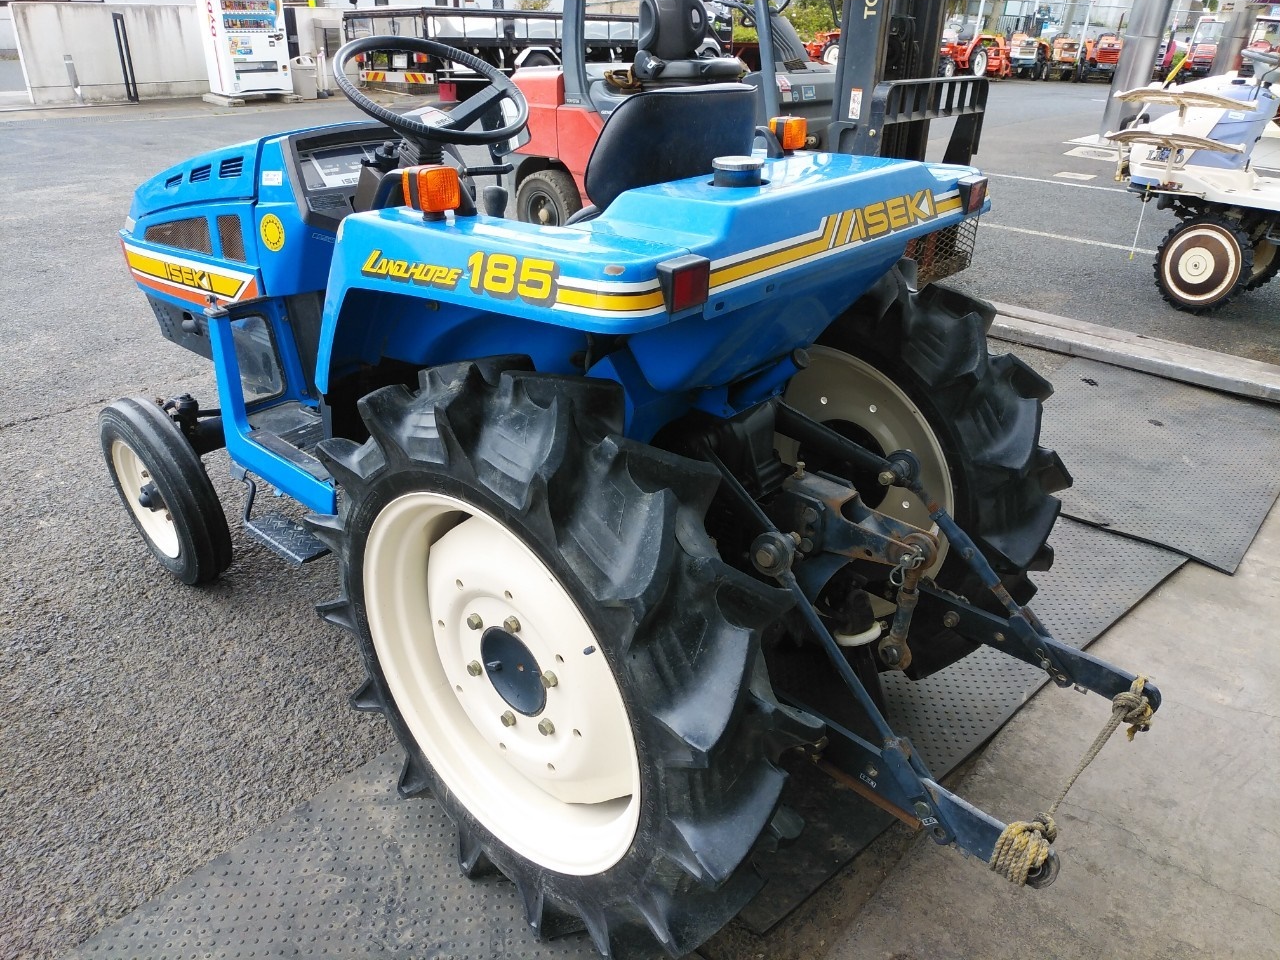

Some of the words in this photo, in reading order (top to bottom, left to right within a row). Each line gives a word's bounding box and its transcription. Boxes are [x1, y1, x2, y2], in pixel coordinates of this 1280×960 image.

[853, 188, 938, 241] ISEKI
[165, 262, 214, 291] ISEKI
[468, 250, 560, 307] 185
